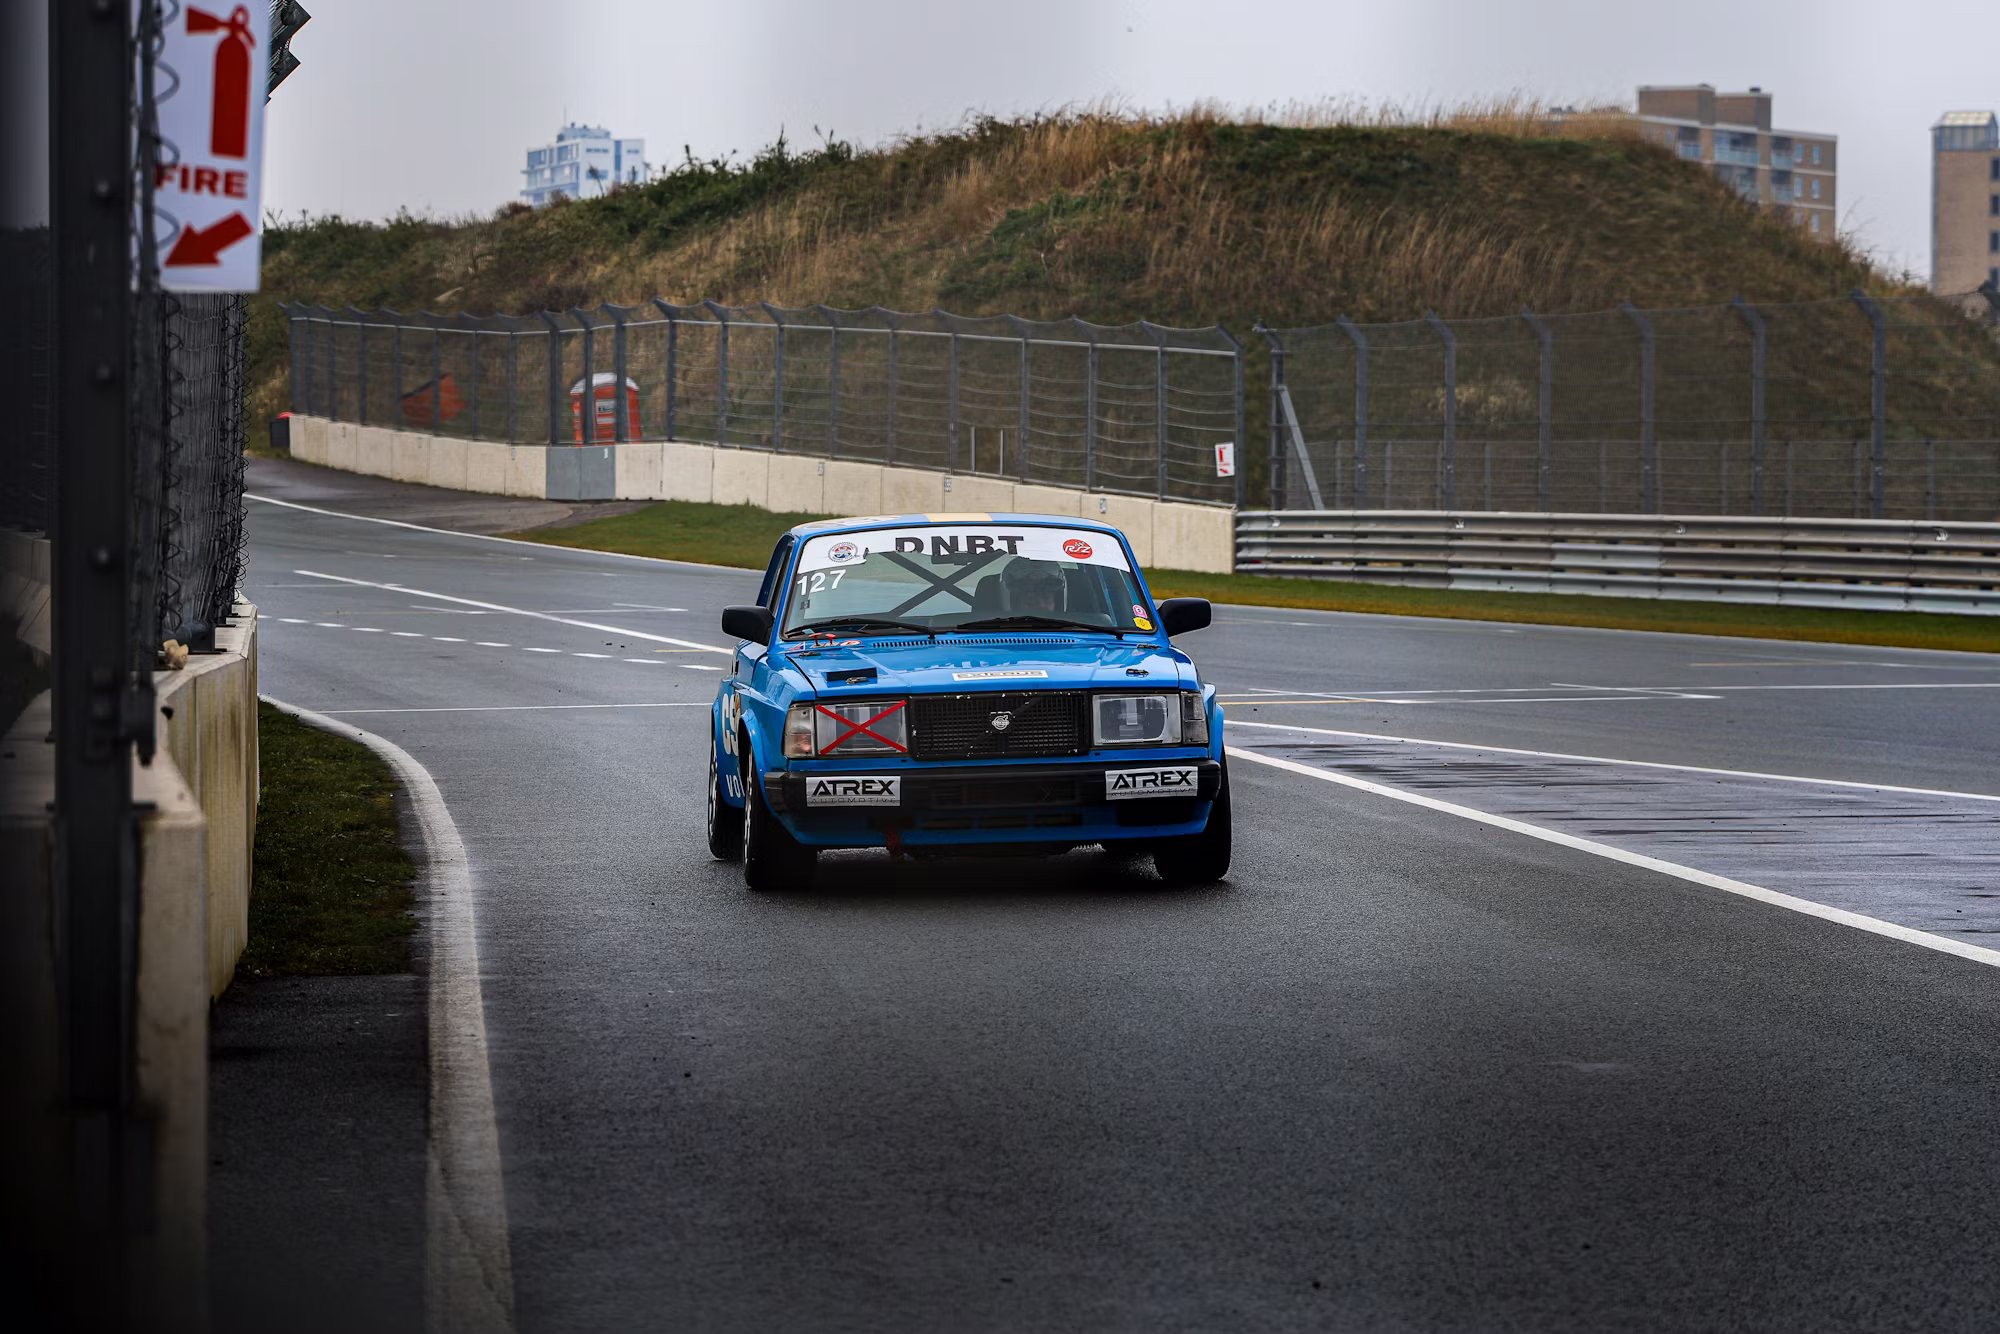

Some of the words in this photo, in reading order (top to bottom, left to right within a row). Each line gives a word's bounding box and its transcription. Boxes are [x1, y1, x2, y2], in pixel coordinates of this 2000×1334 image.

[154, 164, 248, 198] FIRE
[797, 569, 847, 596] 127
[812, 780, 895, 796] ATREX
[1111, 770, 1193, 790] ATREX
